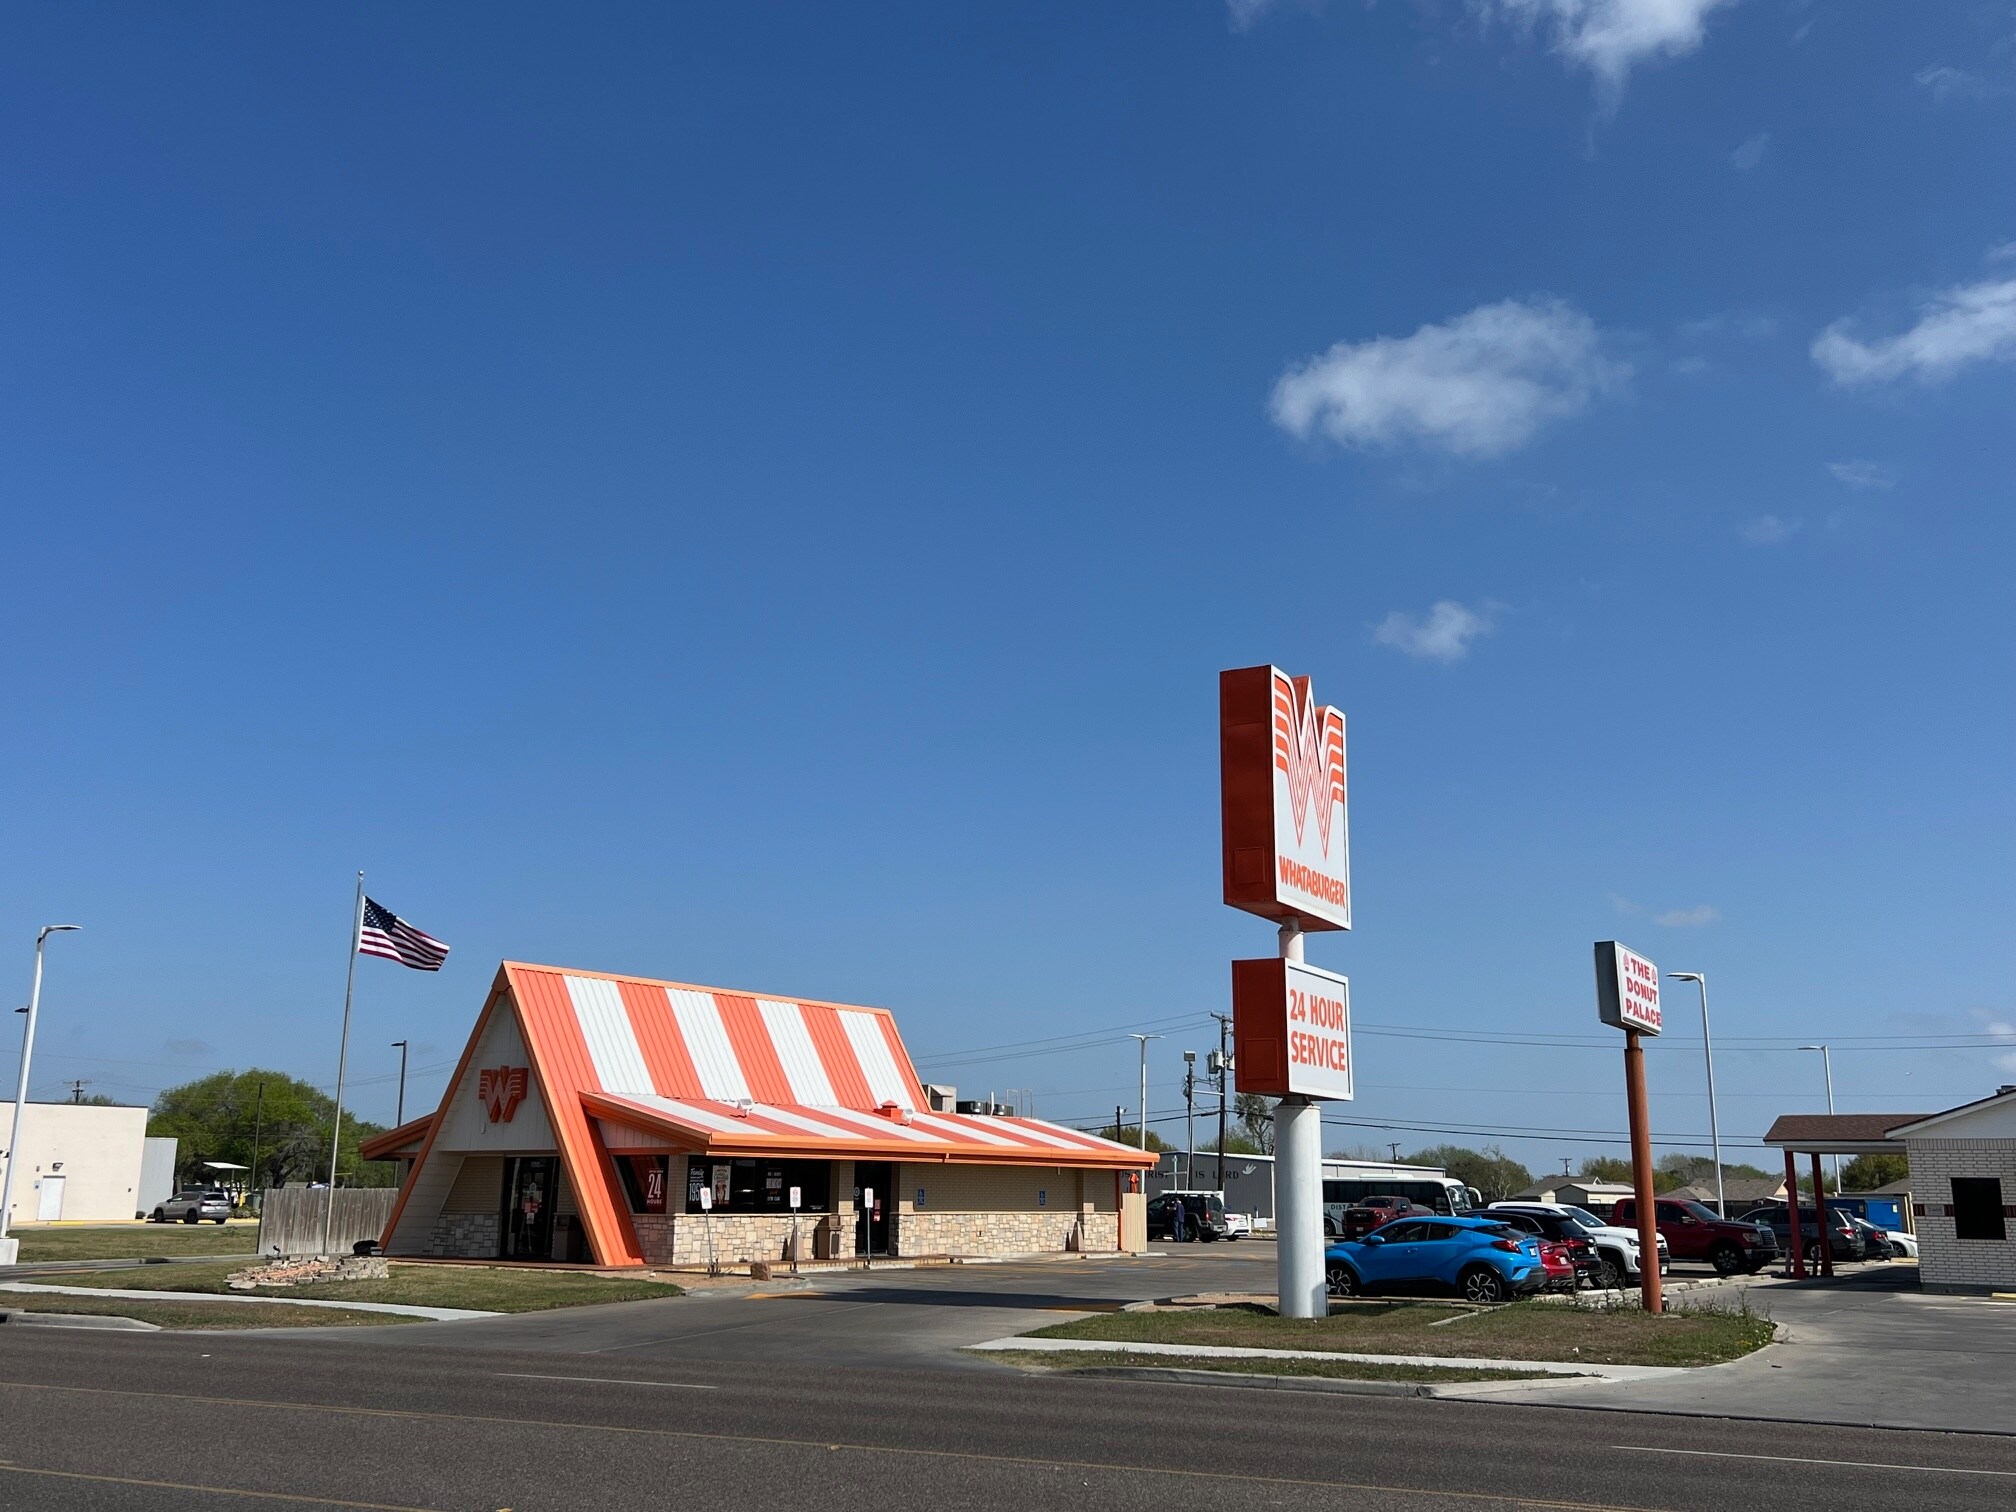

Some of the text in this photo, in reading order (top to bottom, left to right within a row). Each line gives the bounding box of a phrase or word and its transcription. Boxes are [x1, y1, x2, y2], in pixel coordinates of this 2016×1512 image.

[1278, 855, 1346, 908] WHATABURGER
[1630, 957, 1651, 981] THE
[1626, 976, 1658, 1005] DONUT
[1289, 988, 1344, 1032] 24 HOUR
[1625, 997, 1662, 1027] PALACE
[1290, 1030, 1346, 1072] SERVICE
[647, 1173, 662, 1198] 24
[1195, 1171, 1205, 1179] IS
[1212, 1170, 1239, 1179] LRD
